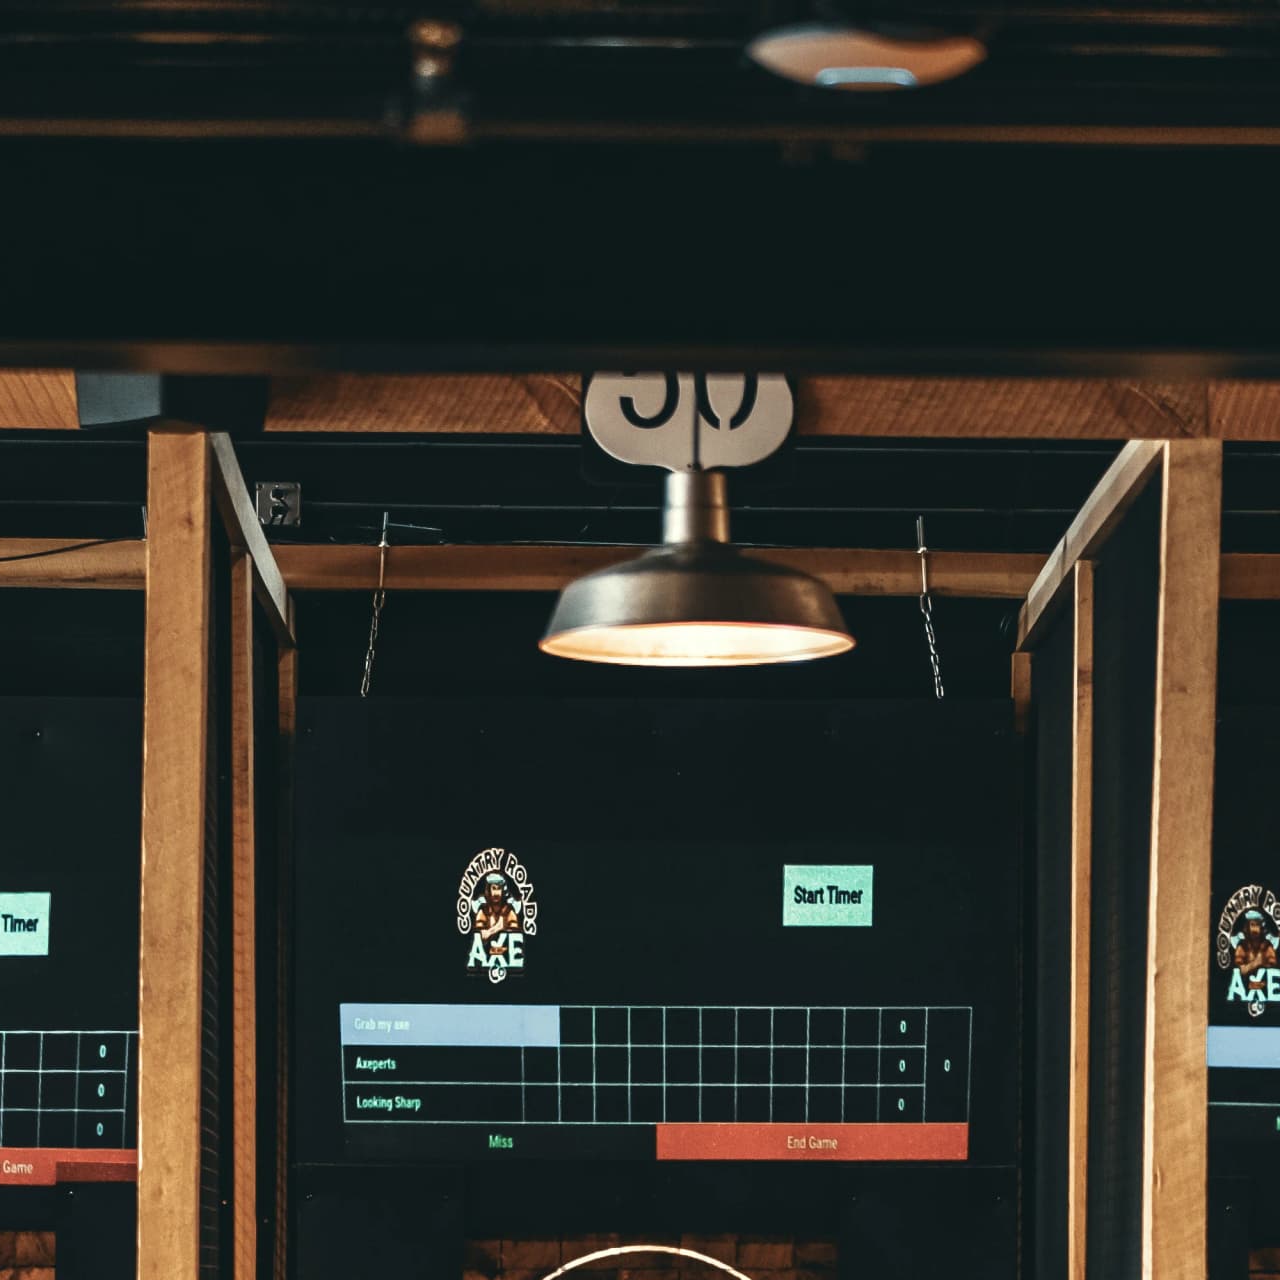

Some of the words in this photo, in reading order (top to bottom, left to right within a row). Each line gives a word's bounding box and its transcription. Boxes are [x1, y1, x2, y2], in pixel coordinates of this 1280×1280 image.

[457, 848, 504, 934] COUNTRY
[505, 853, 538, 935] ROADS
[794, 885, 824, 904] Start
[826, 885, 863, 904] Timer
[1, 914, 39, 933] Timer
[1217, 884, 1262, 969] COUNTRY
[467, 933, 524, 967] AXE
[354, 1018, 376, 1031] Grab
[377, 1020, 392, 1032] my
[394, 1020, 410, 1031] axe
[900, 1020, 907, 1033] 0
[99, 1044, 107, 1058] 0
[356, 1057, 396, 1072] Axeperts
[899, 1059, 906, 1072] 0
[944, 1059, 951, 1072] 0
[98, 1083, 105, 1097] 0
[356, 1096, 392, 1111] Looking
[395, 1096, 421, 1112] Sharp
[898, 1098, 905, 1111] 0
[96, 1122, 104, 1136] 0
[489, 1135, 513, 1148] Miss
[787, 1136, 806, 1149] End
[809, 1136, 838, 1149] Game
[3, 1160, 33, 1174] Game
